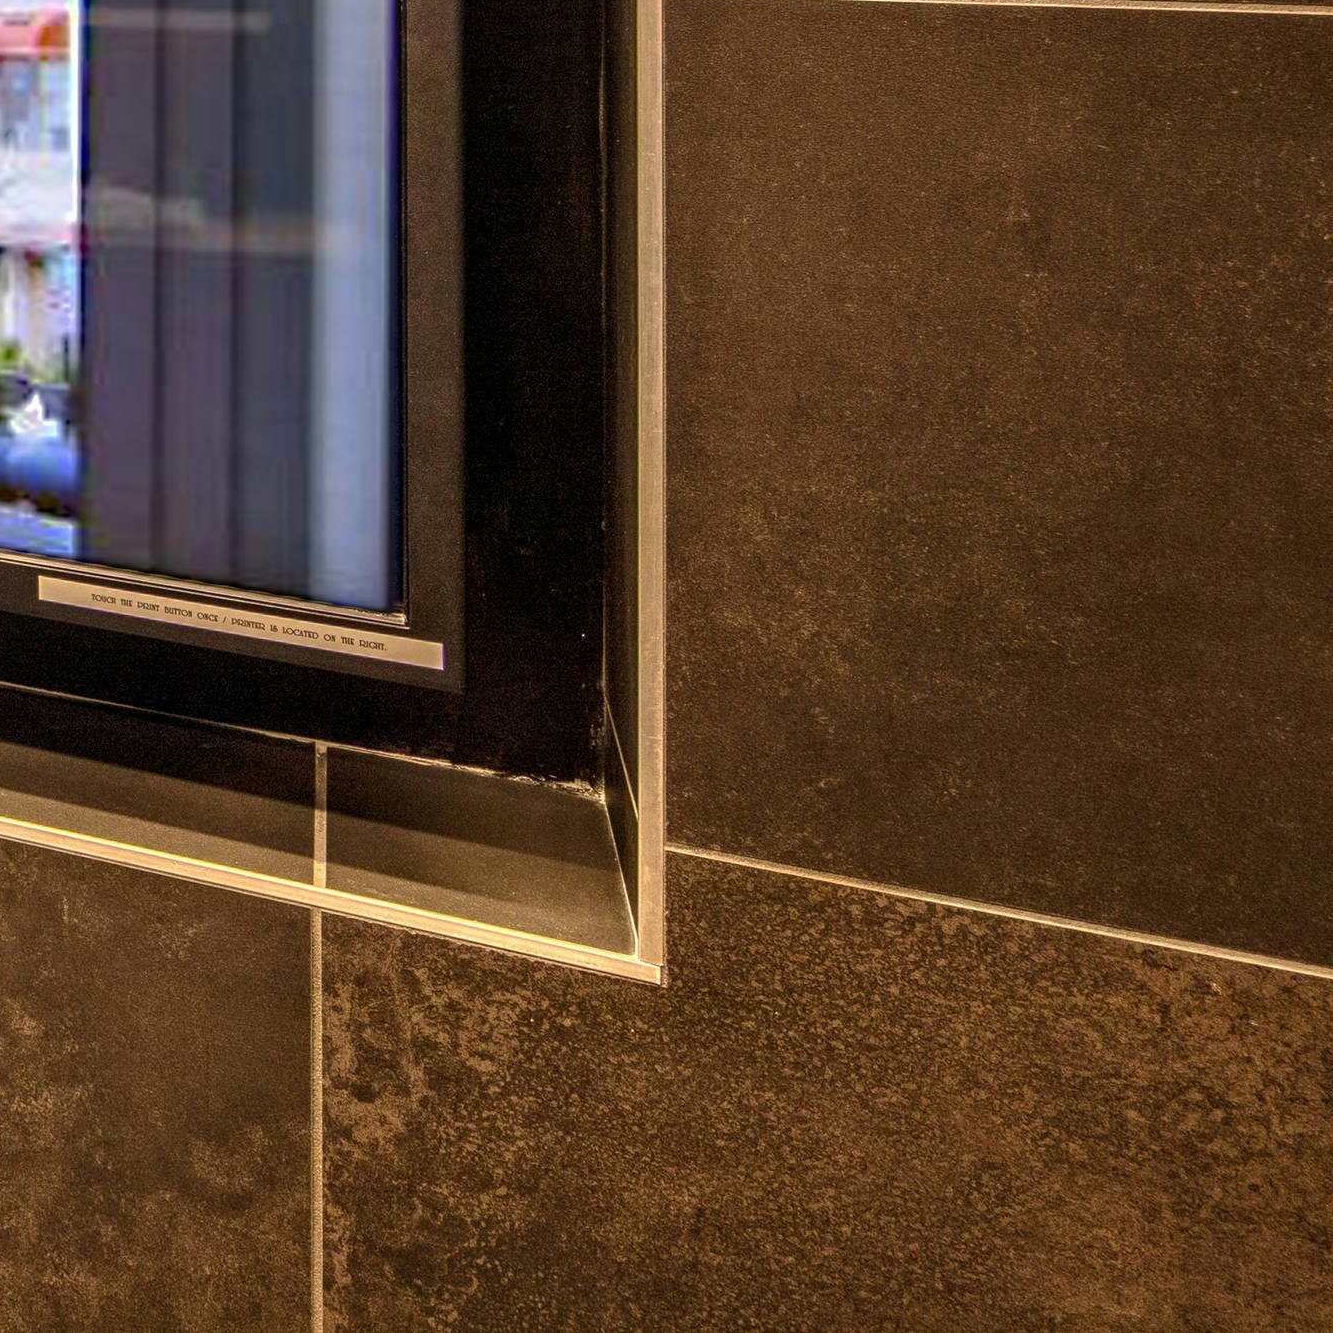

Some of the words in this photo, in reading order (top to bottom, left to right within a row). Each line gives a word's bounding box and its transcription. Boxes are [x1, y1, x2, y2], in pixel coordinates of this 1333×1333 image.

[91, 593, 117, 604] TOUCH
[120, 598, 133, 607] THE
[137, 601, 160, 612] PRINT
[164, 606, 193, 617] BUTTON
[197, 611, 219, 623] ONCE
[231, 617, 266, 631] PRINTER
[282, 626, 319, 639] LOCATED
[323, 633, 336, 642] ON
[340, 635, 355, 646] THE
